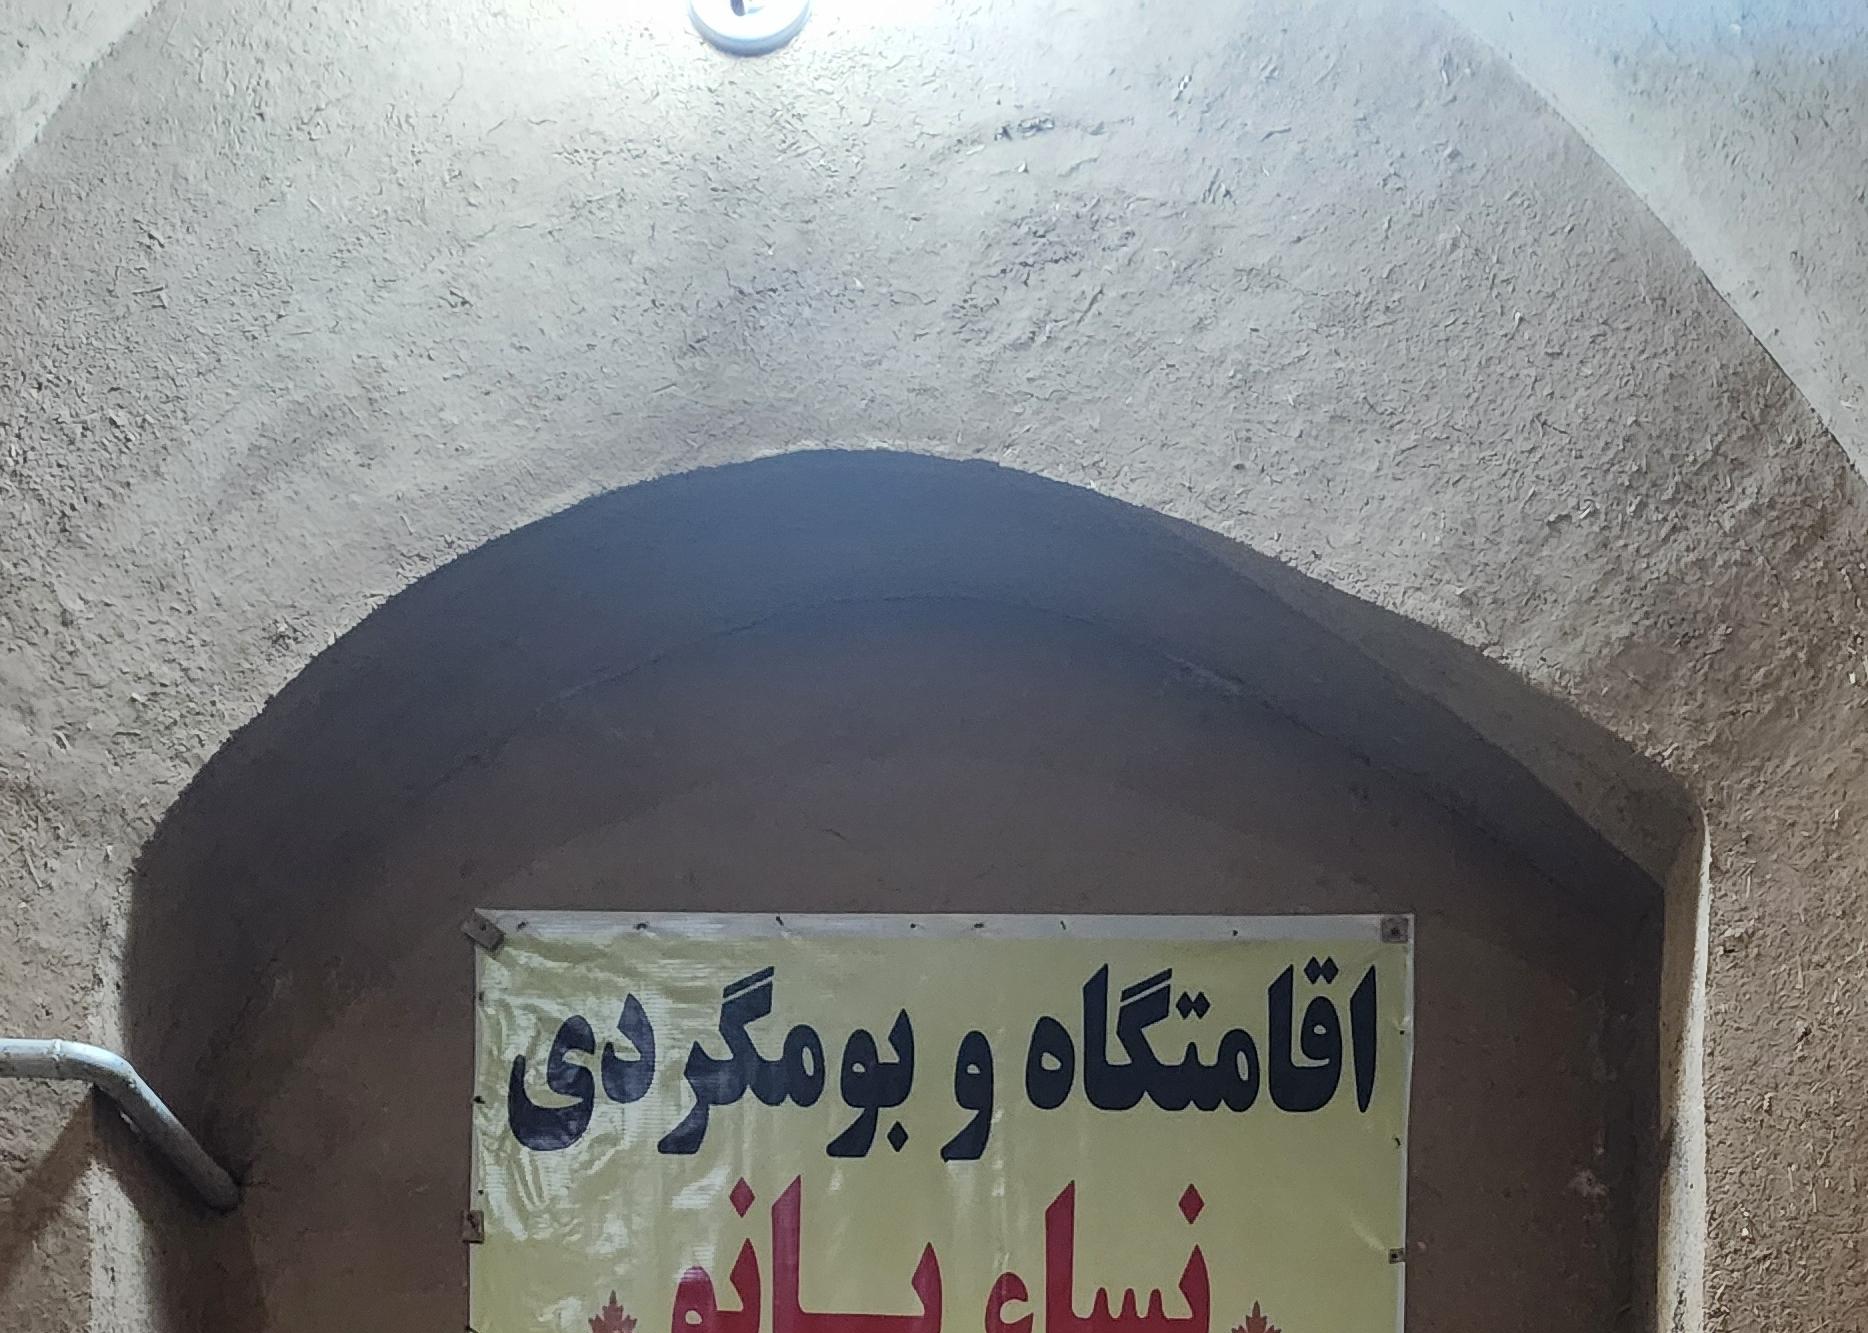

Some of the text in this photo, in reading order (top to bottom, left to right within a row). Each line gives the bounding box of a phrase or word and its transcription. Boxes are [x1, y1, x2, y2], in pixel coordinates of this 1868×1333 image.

[506, 956, 1377, 1161] اقامتگاه و بومگردی
